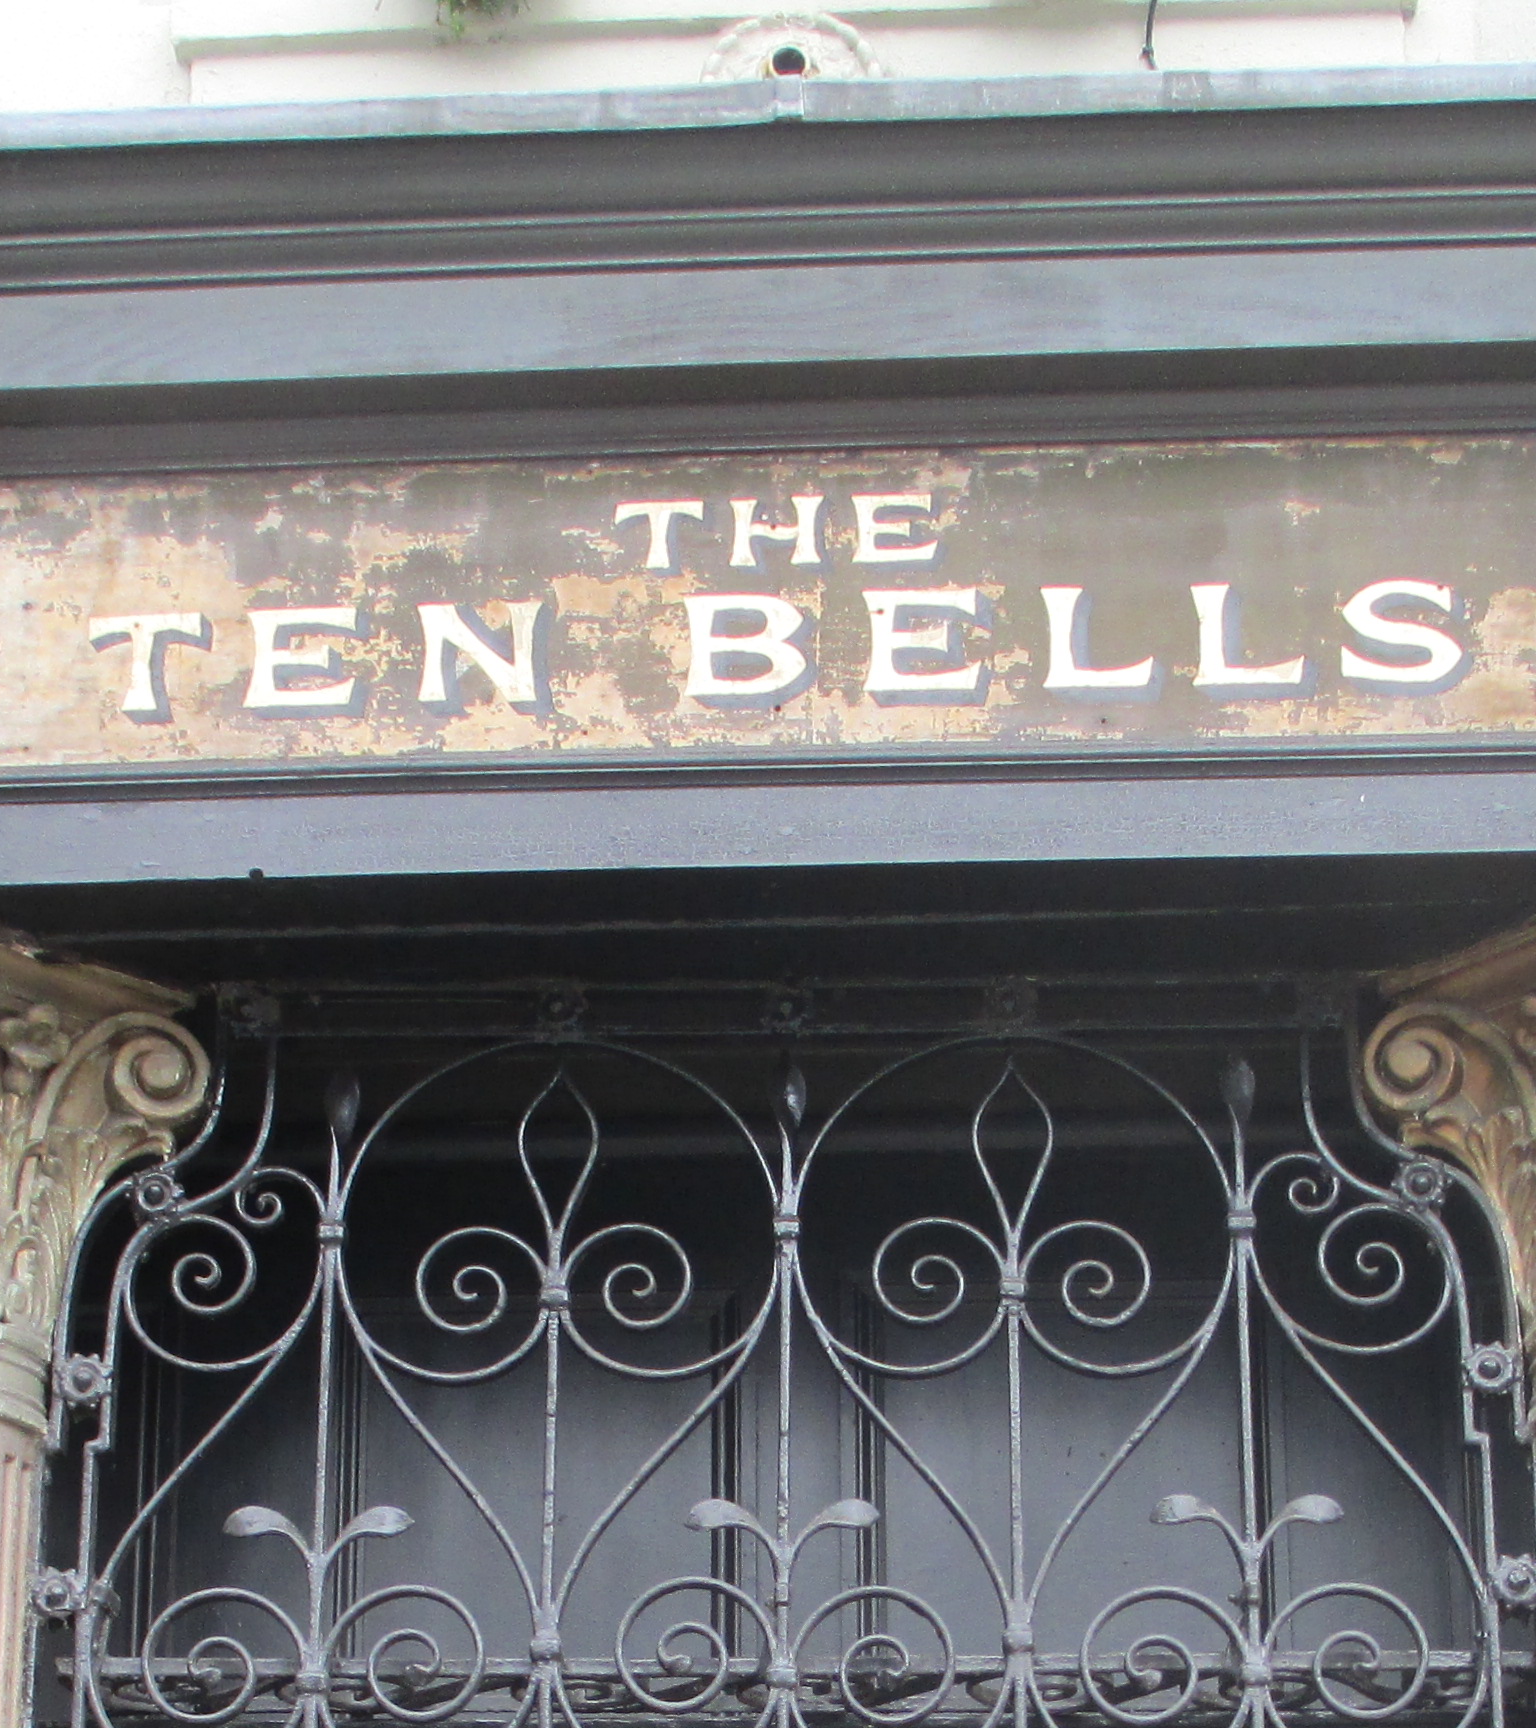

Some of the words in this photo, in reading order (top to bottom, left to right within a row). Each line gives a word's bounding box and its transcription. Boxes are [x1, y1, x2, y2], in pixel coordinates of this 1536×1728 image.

[614, 492, 939, 570] THE
[88, 598, 554, 714] TEN
[682, 580, 1466, 704] BELLS
